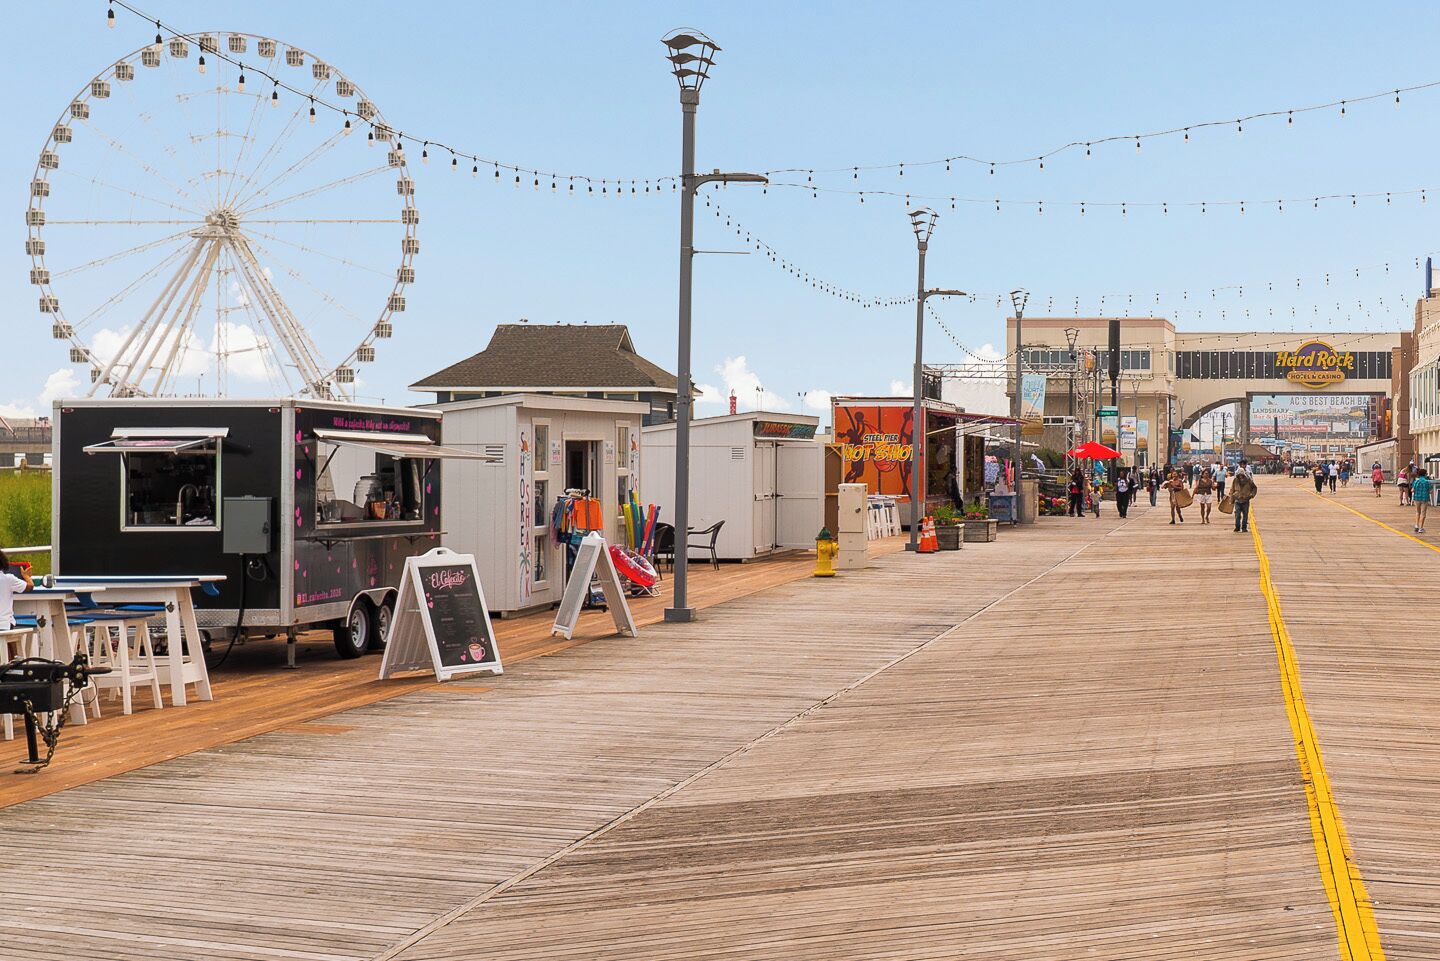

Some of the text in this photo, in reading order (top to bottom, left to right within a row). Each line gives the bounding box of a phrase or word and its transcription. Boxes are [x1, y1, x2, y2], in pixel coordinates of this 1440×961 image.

[1275, 351, 1354, 369] Hard Rock
[1290, 396, 1307, 406] AC'S
[1309, 396, 1327, 406] BEST
[1330, 396, 1355, 406] BEACH
[844, 444, 874, 462] HOT
[432, 572, 439, 588] El
